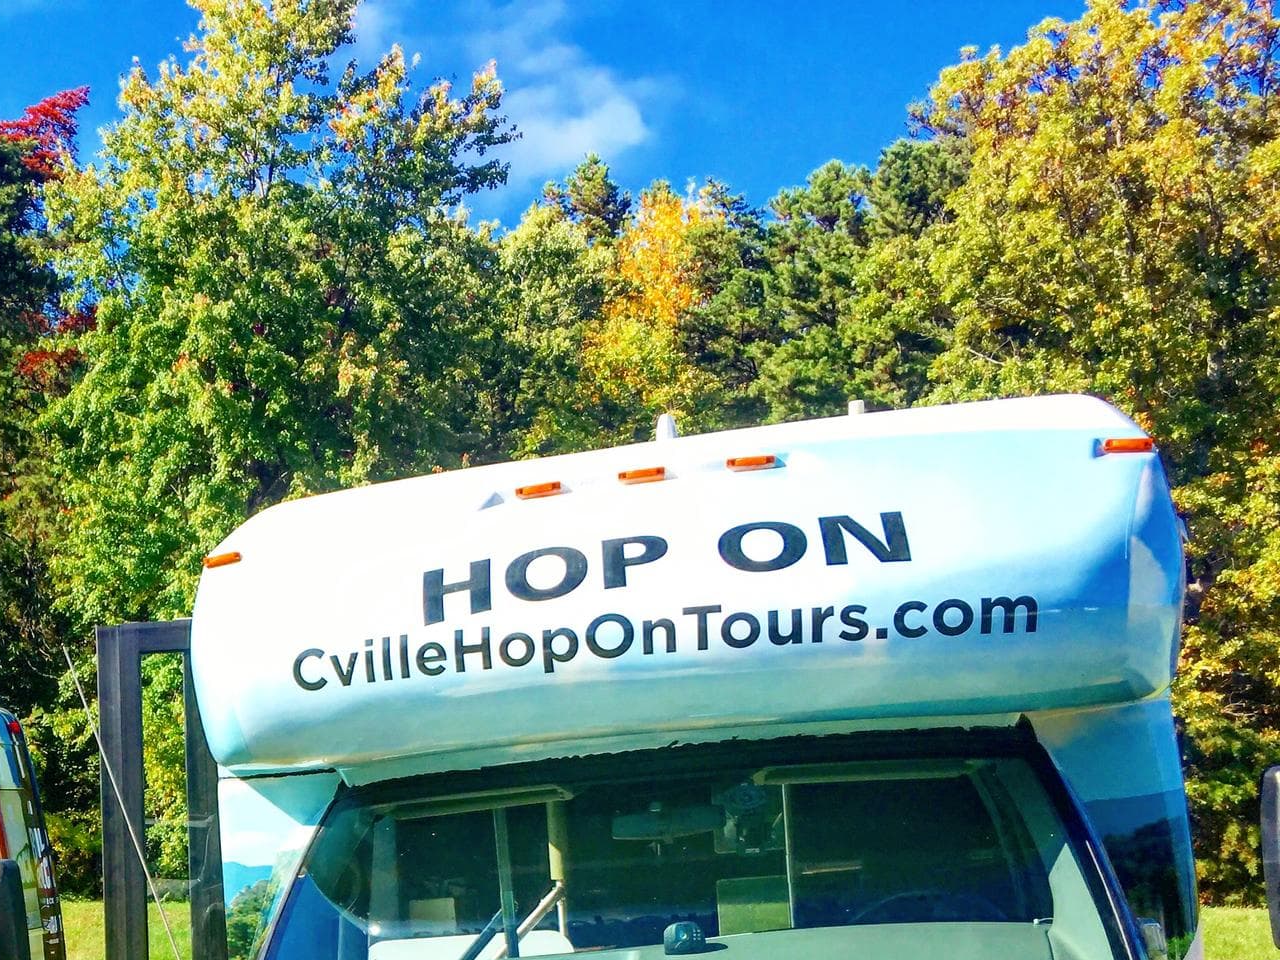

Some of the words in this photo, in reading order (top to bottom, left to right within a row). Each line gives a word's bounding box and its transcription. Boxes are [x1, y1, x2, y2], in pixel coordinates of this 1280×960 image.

[422, 535, 669, 626] HOP
[717, 511, 913, 573] ON
[292, 592, 1039, 692] CvilleHopOnTours.com
